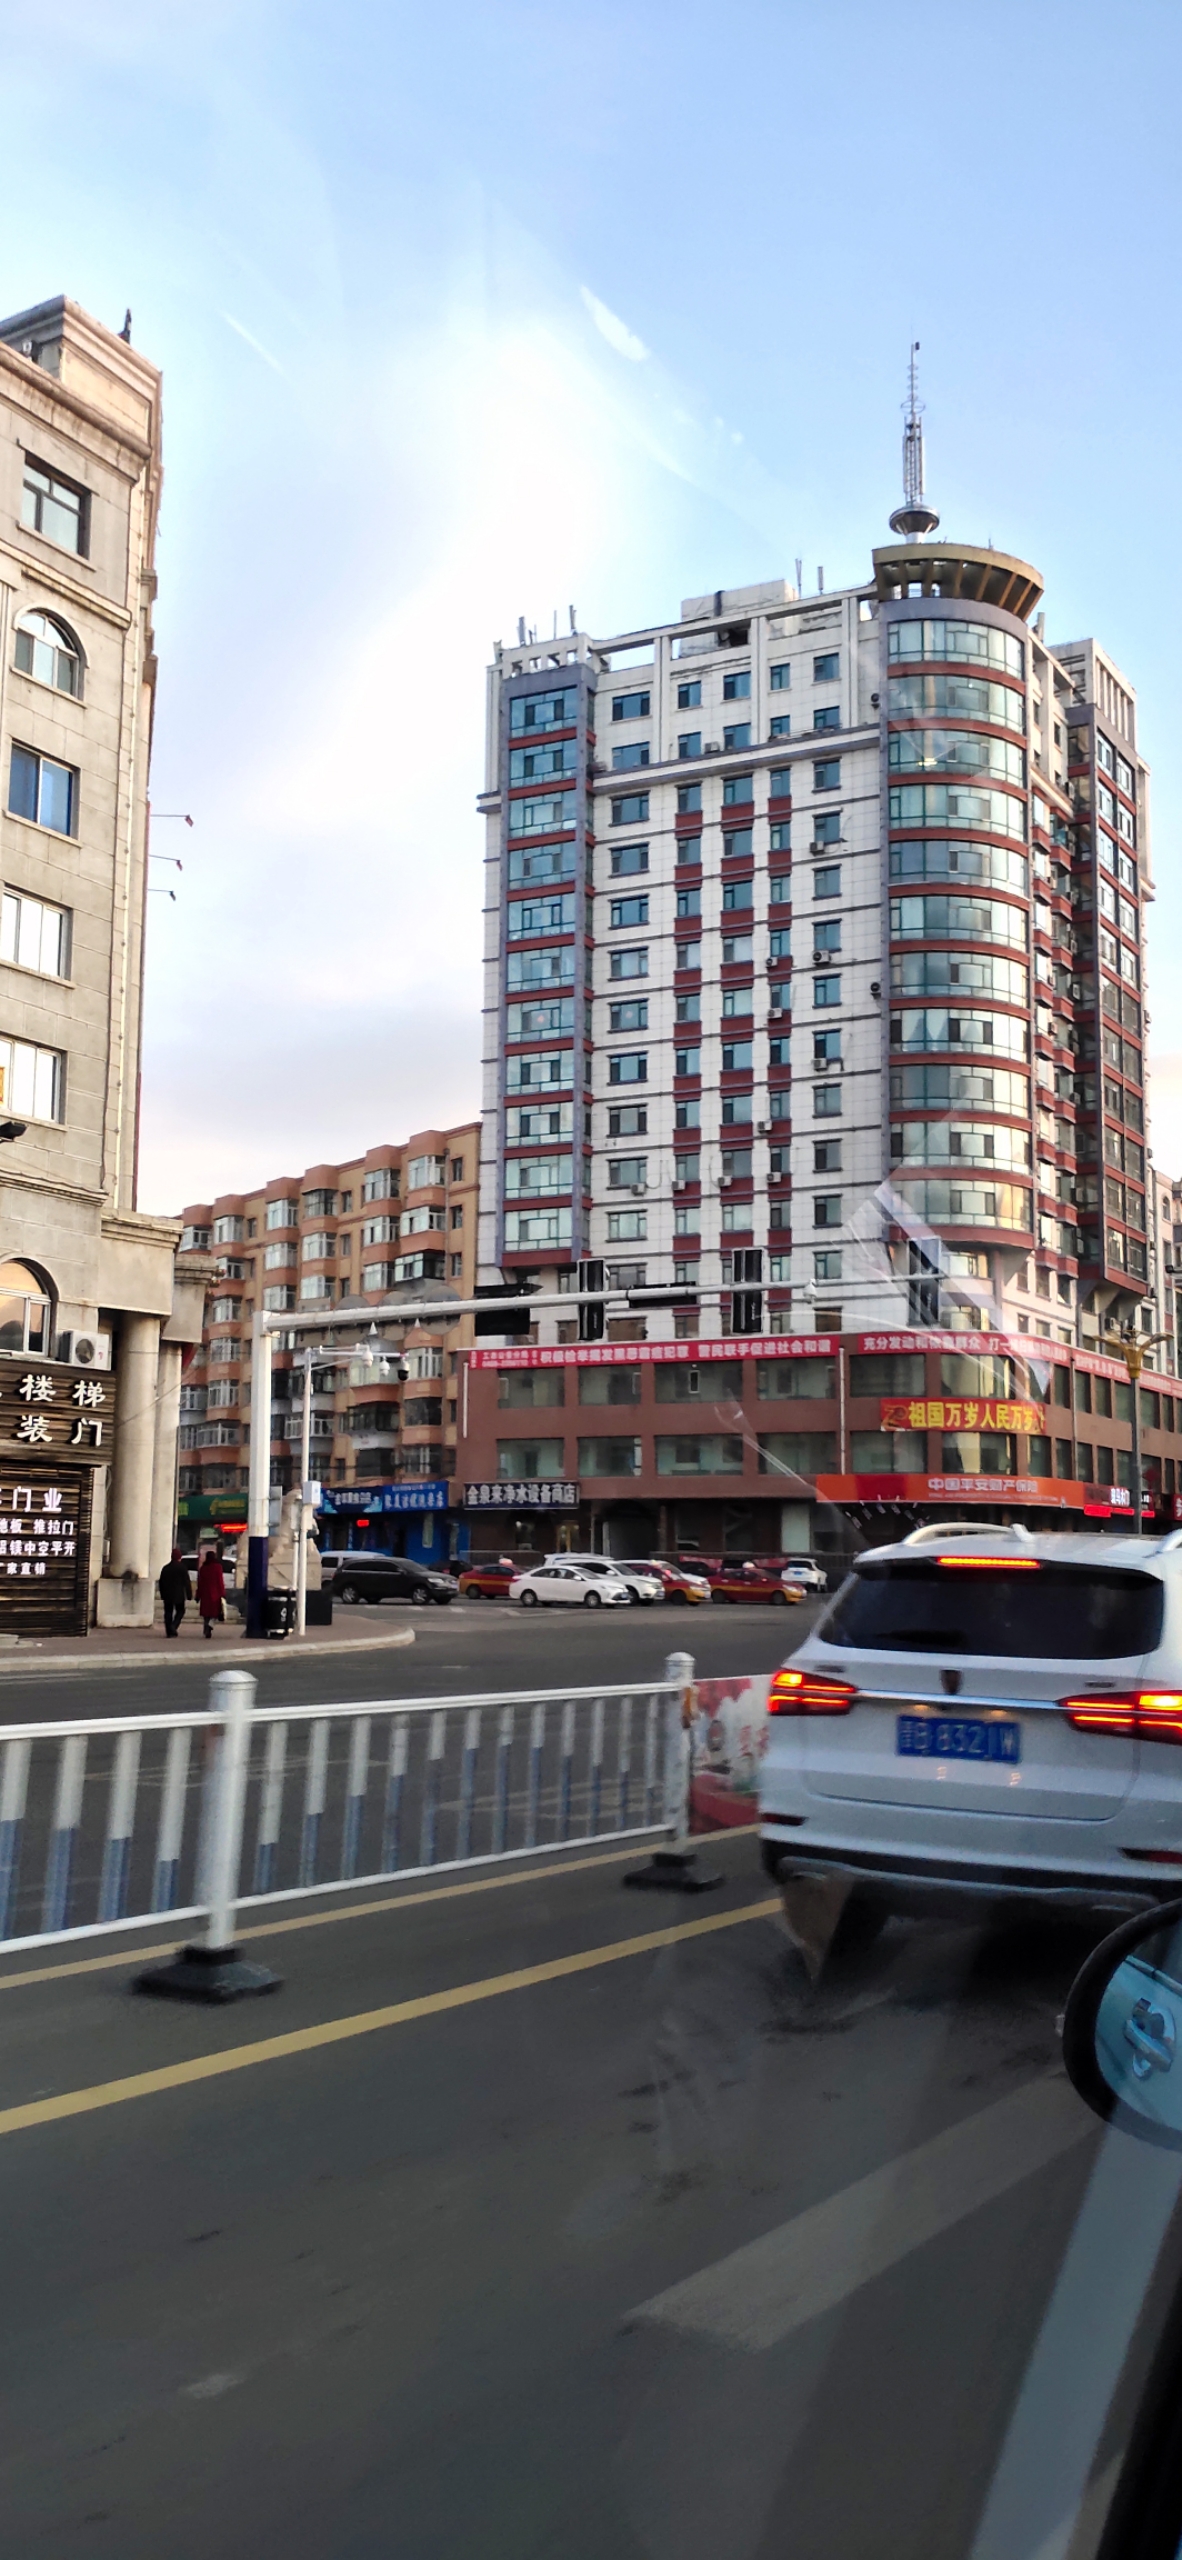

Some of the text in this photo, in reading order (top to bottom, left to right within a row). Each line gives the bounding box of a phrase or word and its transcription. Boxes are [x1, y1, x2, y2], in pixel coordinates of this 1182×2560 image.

[0, 1374, 106, 1407] 楼梯
[909, 1402, 1033, 1431] 祖国万岁人民万岁
[928, 1478, 1038, 1492] 中国平安财产保险
[0, 1486, 62, 1513] 门业
[0, 1562, 46, 1575] 家直销
